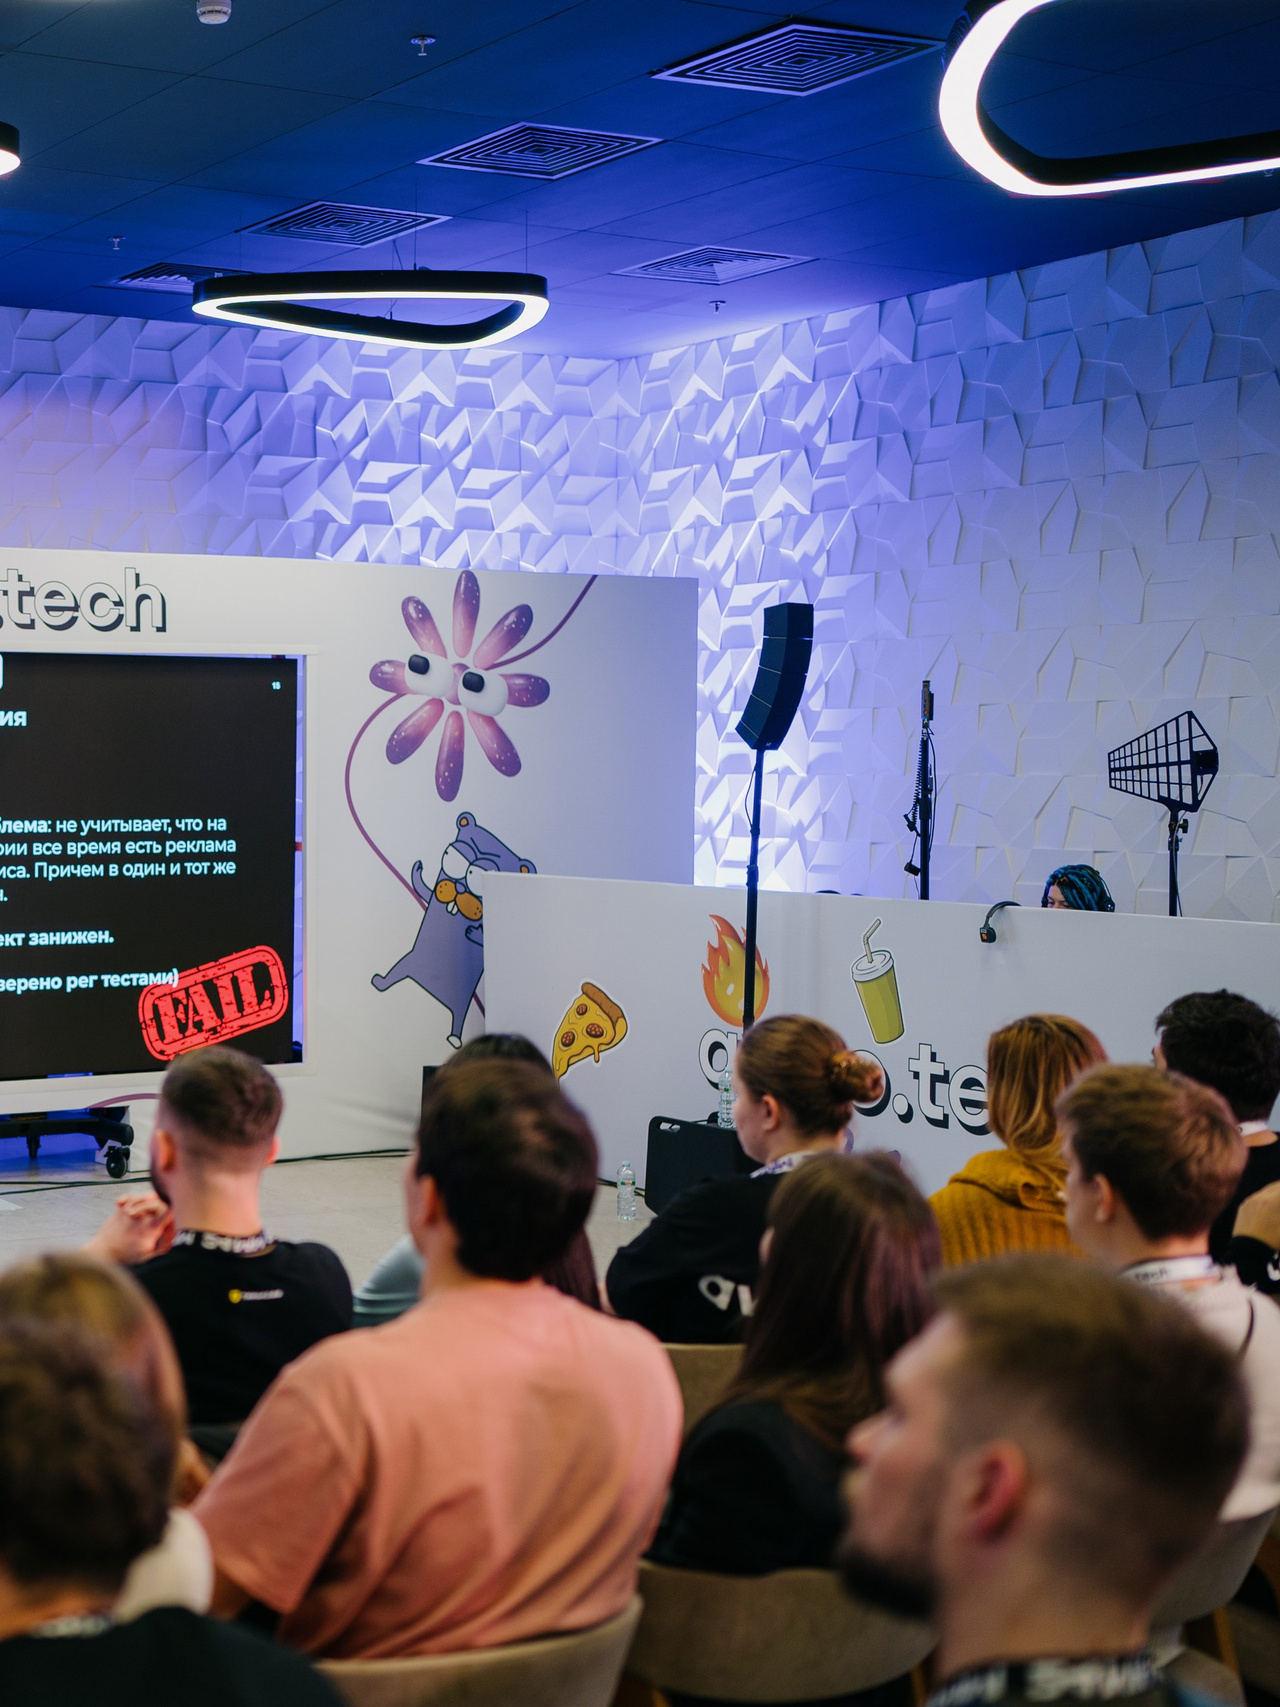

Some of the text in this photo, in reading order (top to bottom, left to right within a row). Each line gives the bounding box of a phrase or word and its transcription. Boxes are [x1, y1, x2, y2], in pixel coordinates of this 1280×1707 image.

[55, 819, 78, 833] не
[80, 818, 172, 837] учитывает,
[175, 818, 204, 832] что
[206, 817, 228, 832] на
[32, 841, 63, 856] все
[66, 840, 122, 859] время
[124, 840, 163, 855] есть
[165, 838, 237, 858] реклама
[34, 861, 105, 882] Причем
[108, 863, 120, 877] в
[122, 862, 166, 879] один
[169, 862, 181, 876] и
[184, 862, 210, 876] тот
[212, 861, 237, 876] же
[28, 928, 115, 947] занижен.
[66, 974, 98, 993] рег
[100, 968, 180, 989] тестами)
[154, 964, 273, 1045] FAIL
